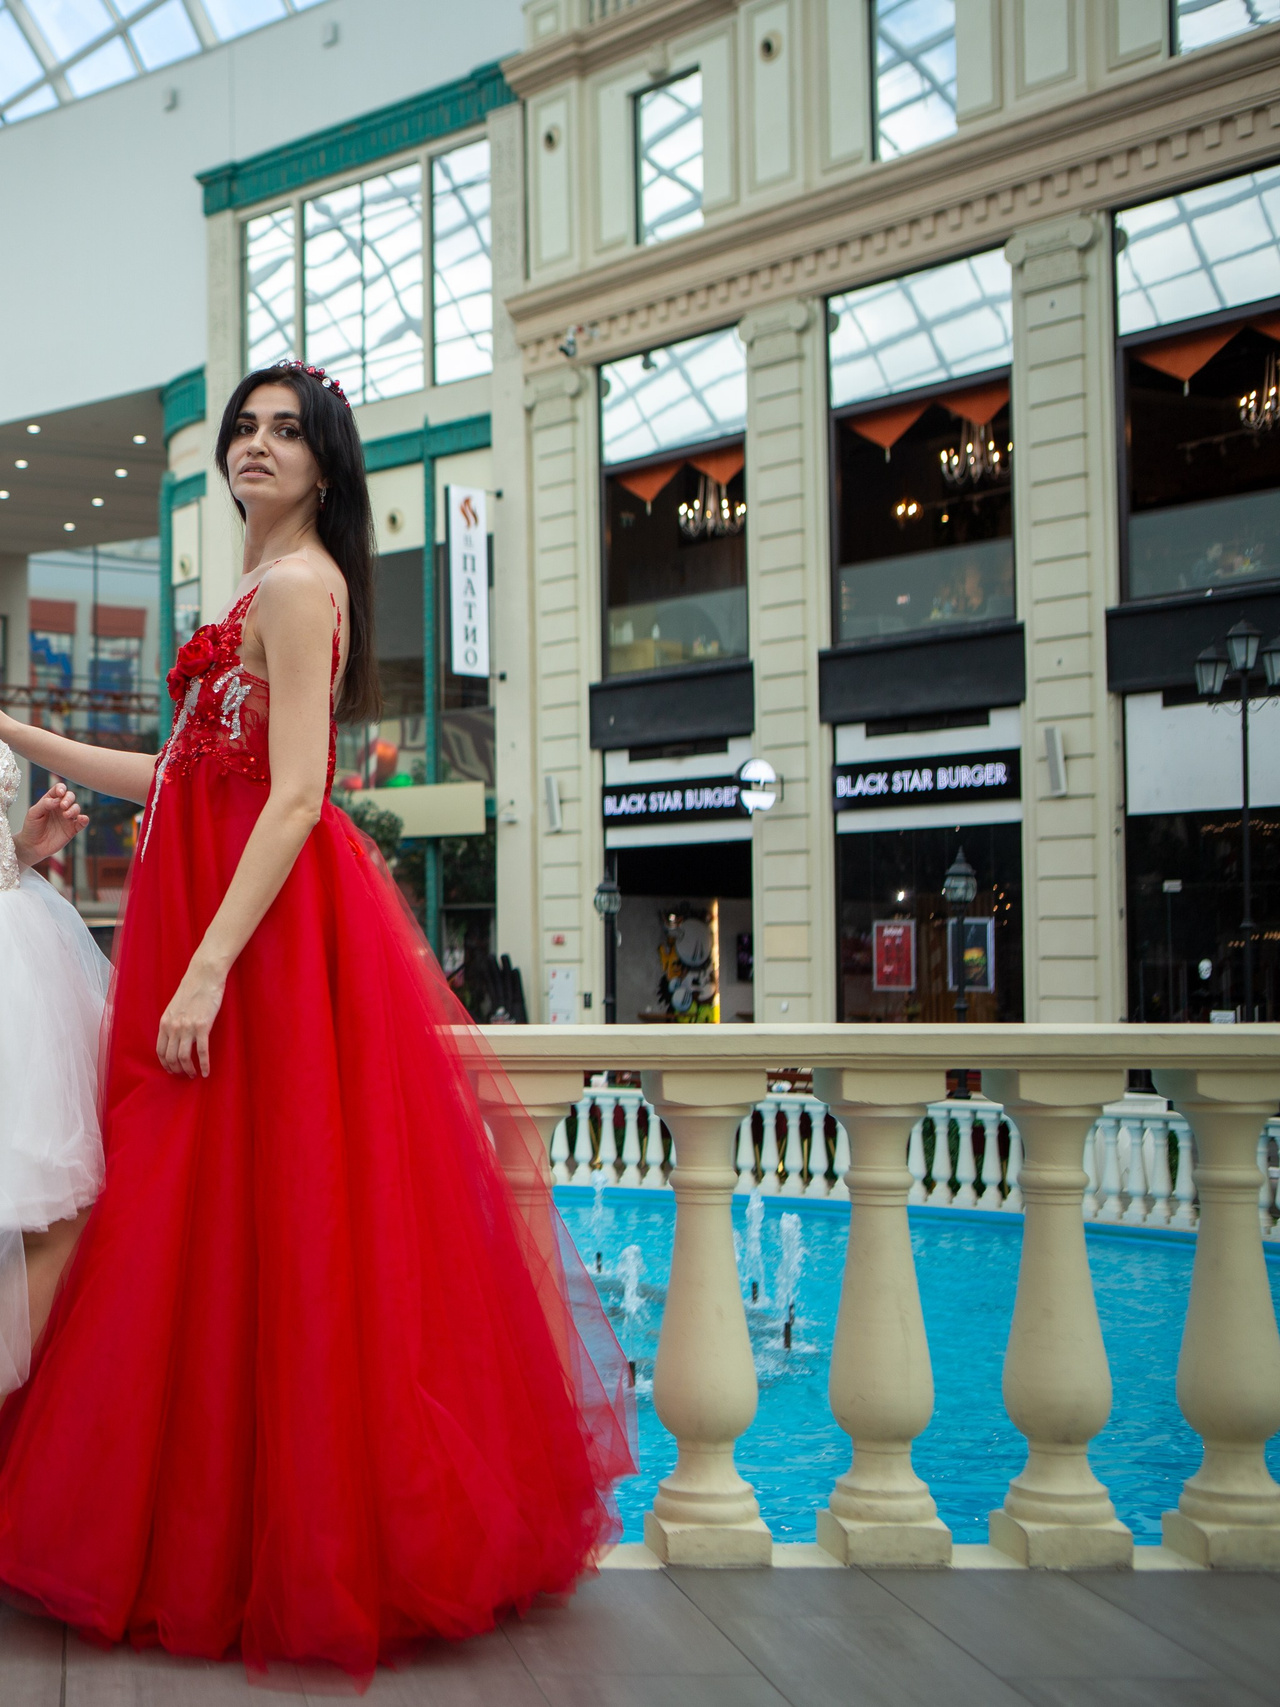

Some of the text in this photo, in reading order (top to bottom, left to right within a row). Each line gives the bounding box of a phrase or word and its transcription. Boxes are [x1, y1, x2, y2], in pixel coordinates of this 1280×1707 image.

[462, 553, 478, 668] ПАТИО
[836, 761, 1008, 798] BLACK STAR BURGER
[604, 793, 647, 816] BLACK
[649, 790, 683, 812] STAR
